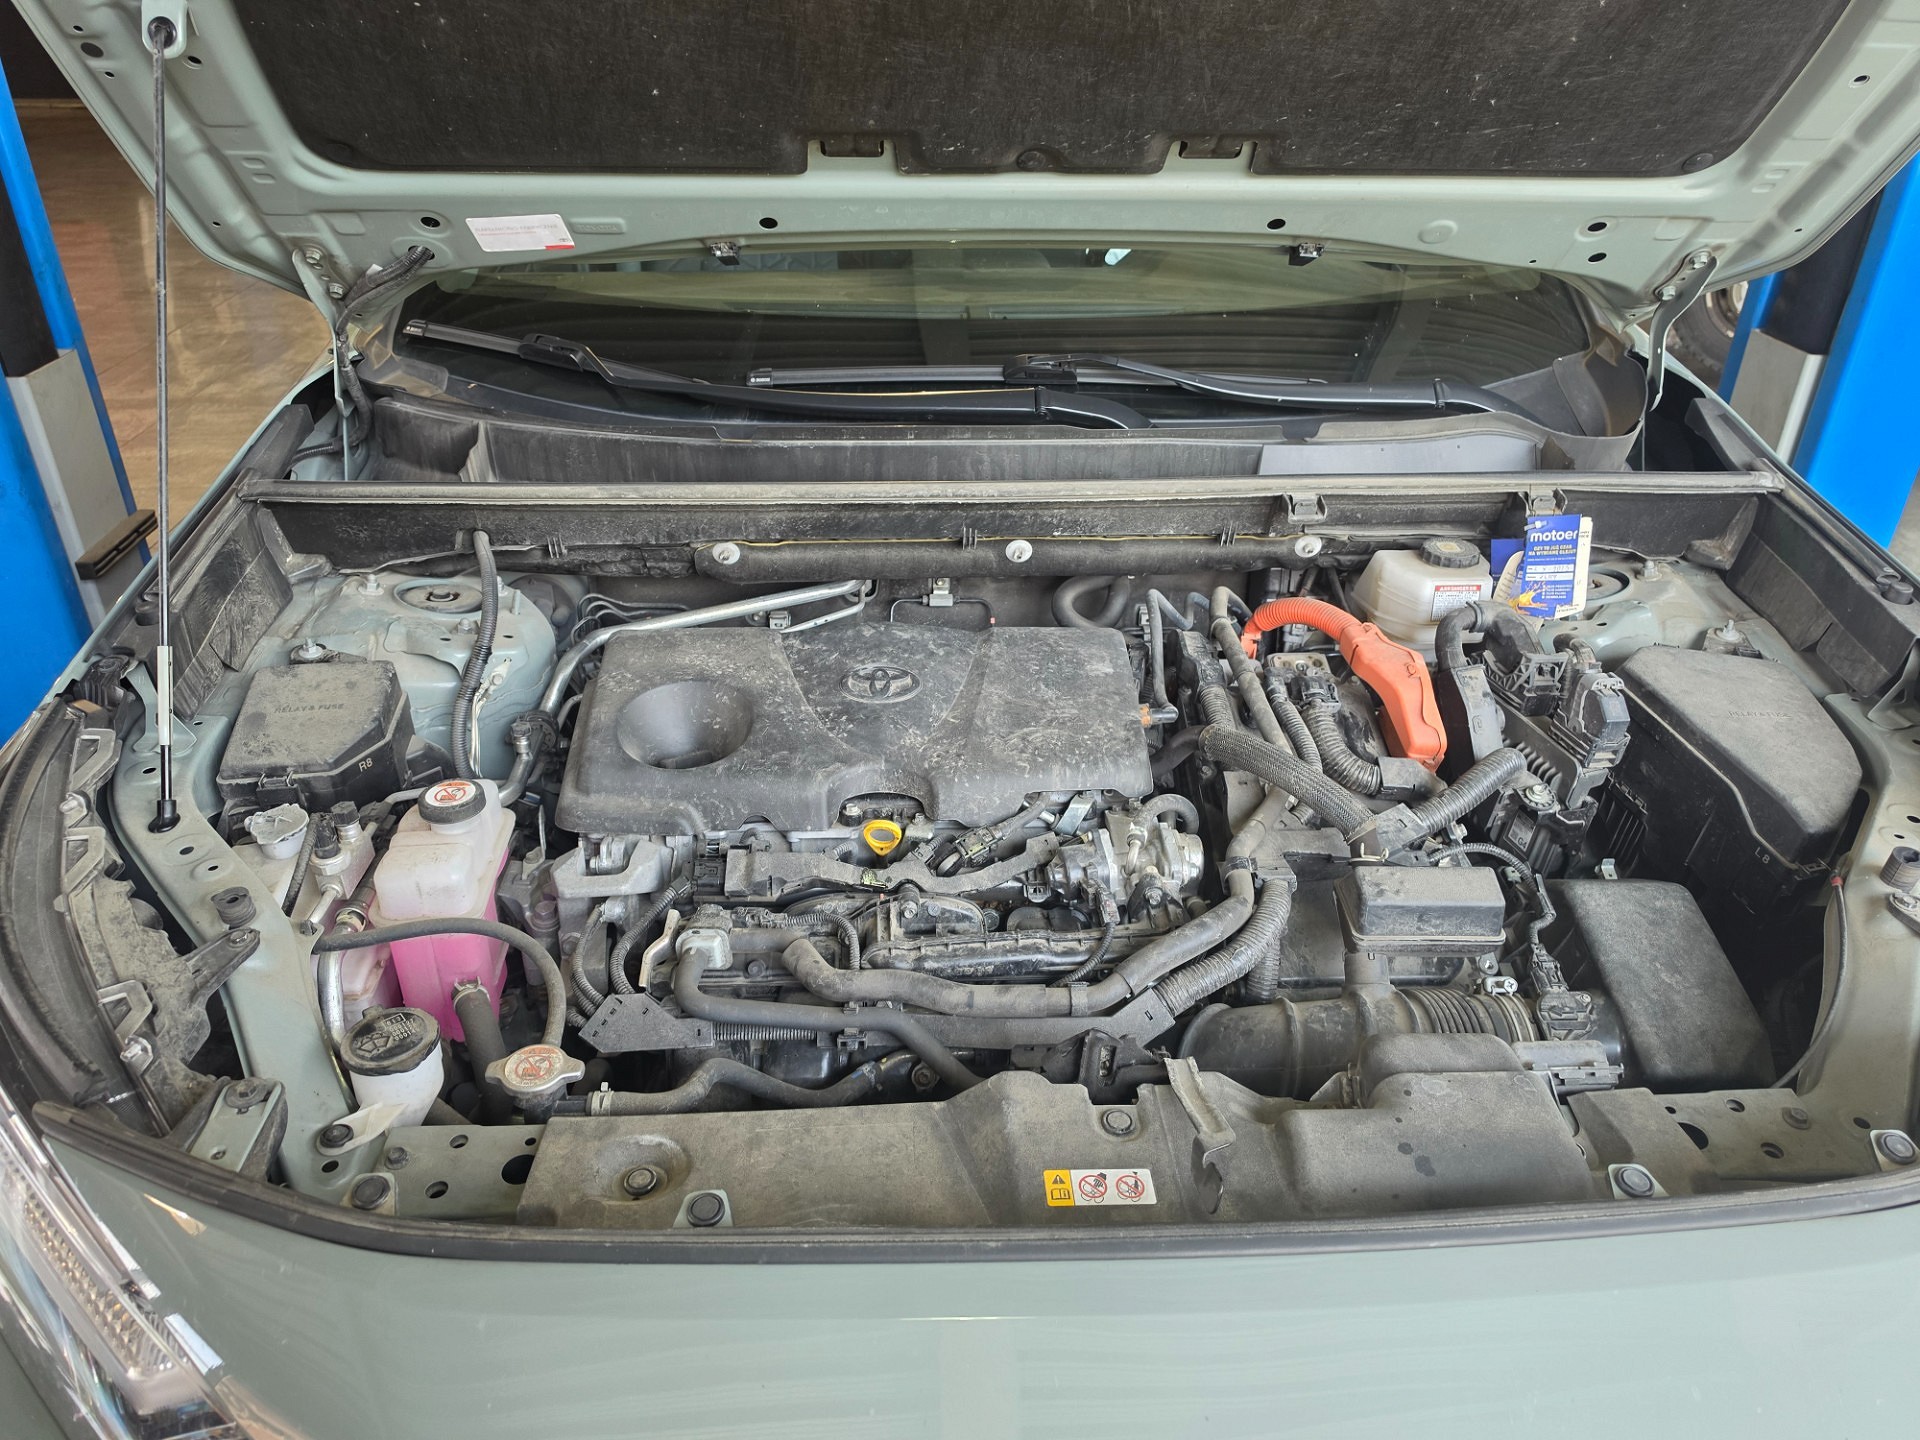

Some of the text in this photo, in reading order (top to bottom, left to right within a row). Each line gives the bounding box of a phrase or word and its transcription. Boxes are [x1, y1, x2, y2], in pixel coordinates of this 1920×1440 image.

[1530, 530, 1578, 542] motoer
[358, 757, 373, 772] R8
[1754, 846, 1770, 864] L8
